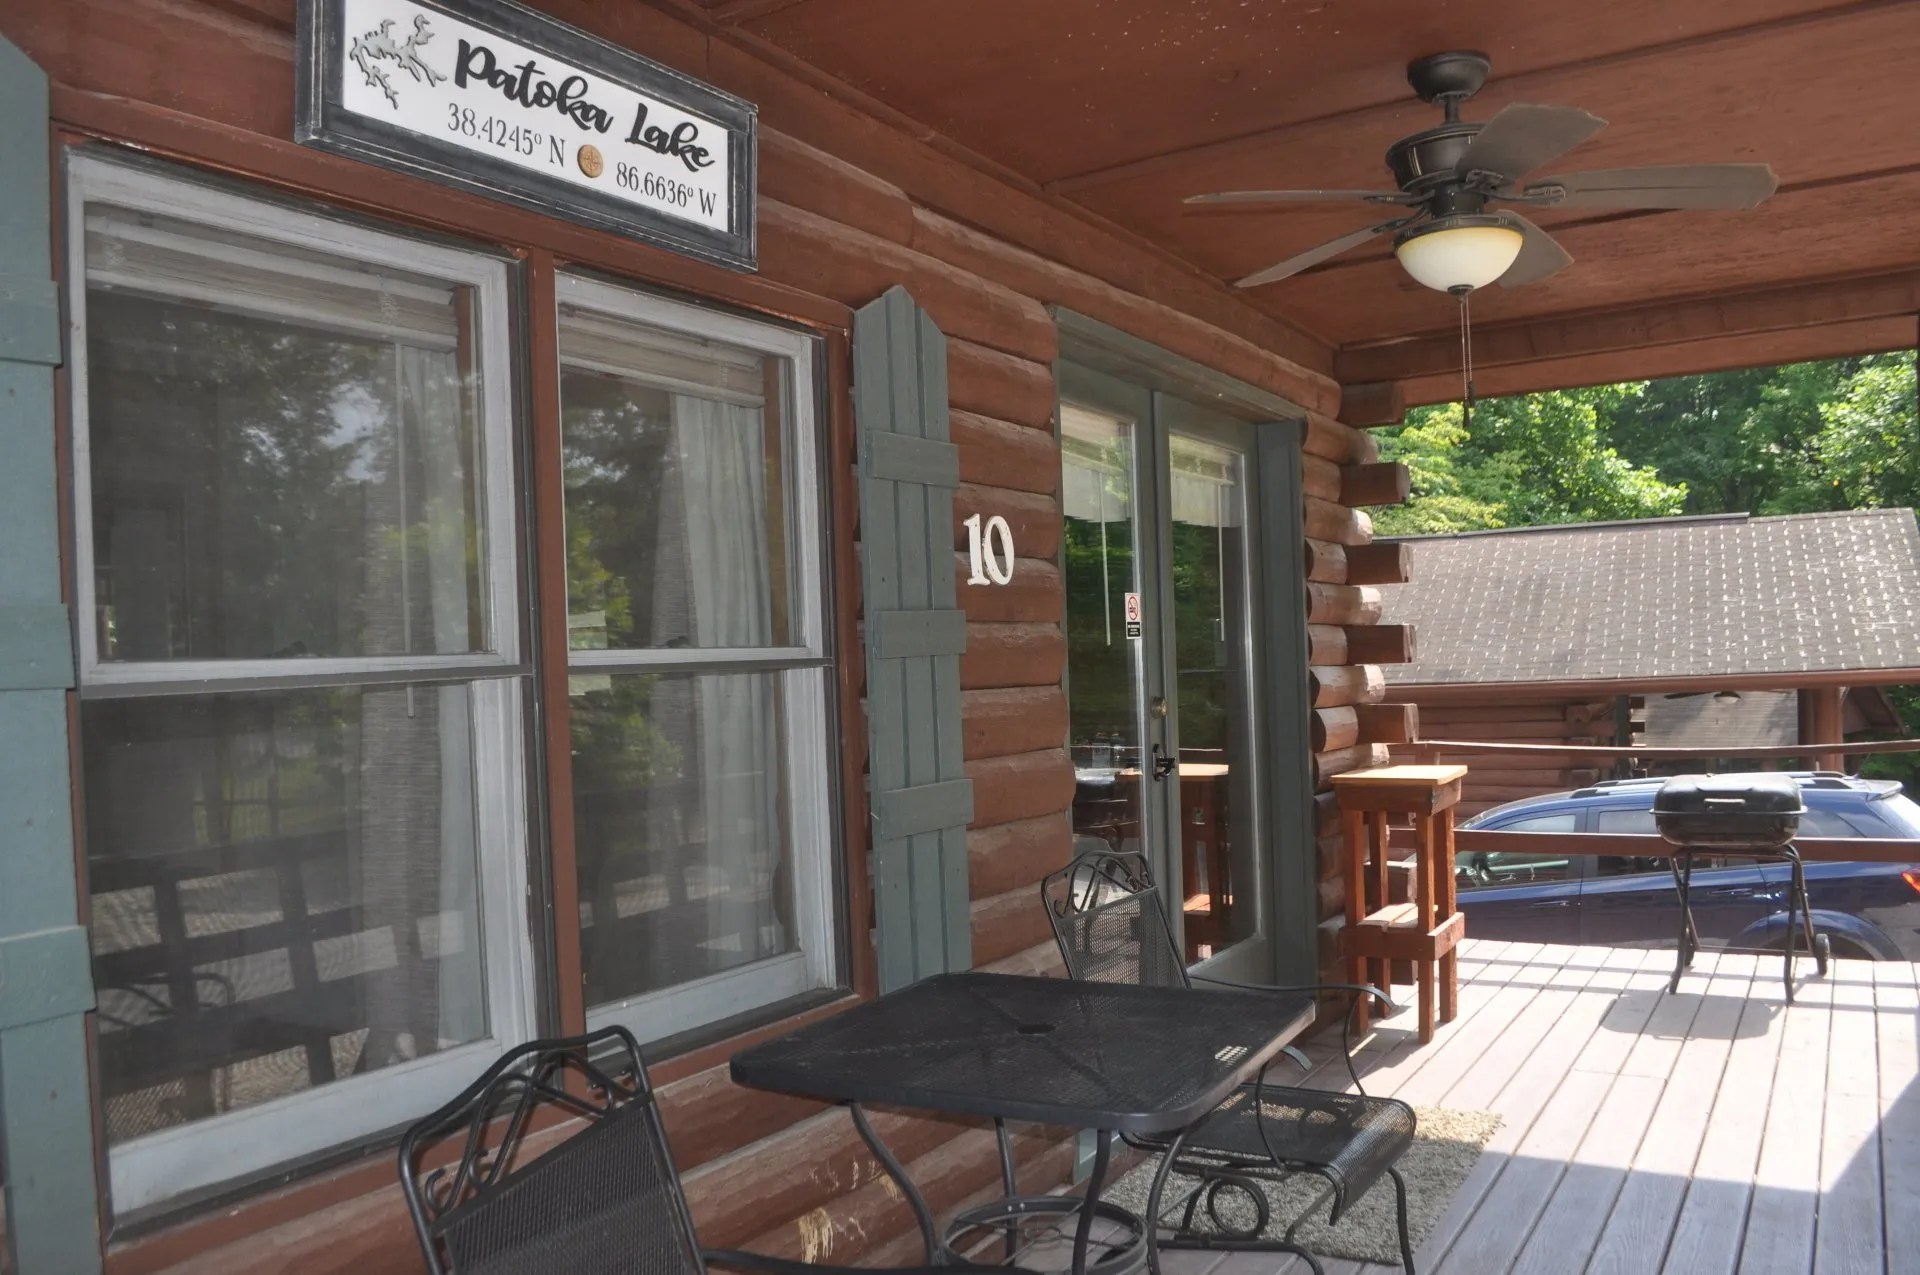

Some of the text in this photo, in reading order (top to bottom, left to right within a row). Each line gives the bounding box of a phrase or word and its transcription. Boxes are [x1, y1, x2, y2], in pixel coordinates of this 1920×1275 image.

[454, 39, 715, 172] Patoka Lake
[549, 137, 565, 167] N
[698, 190, 717, 217] W
[963, 513, 1015, 586] 10
